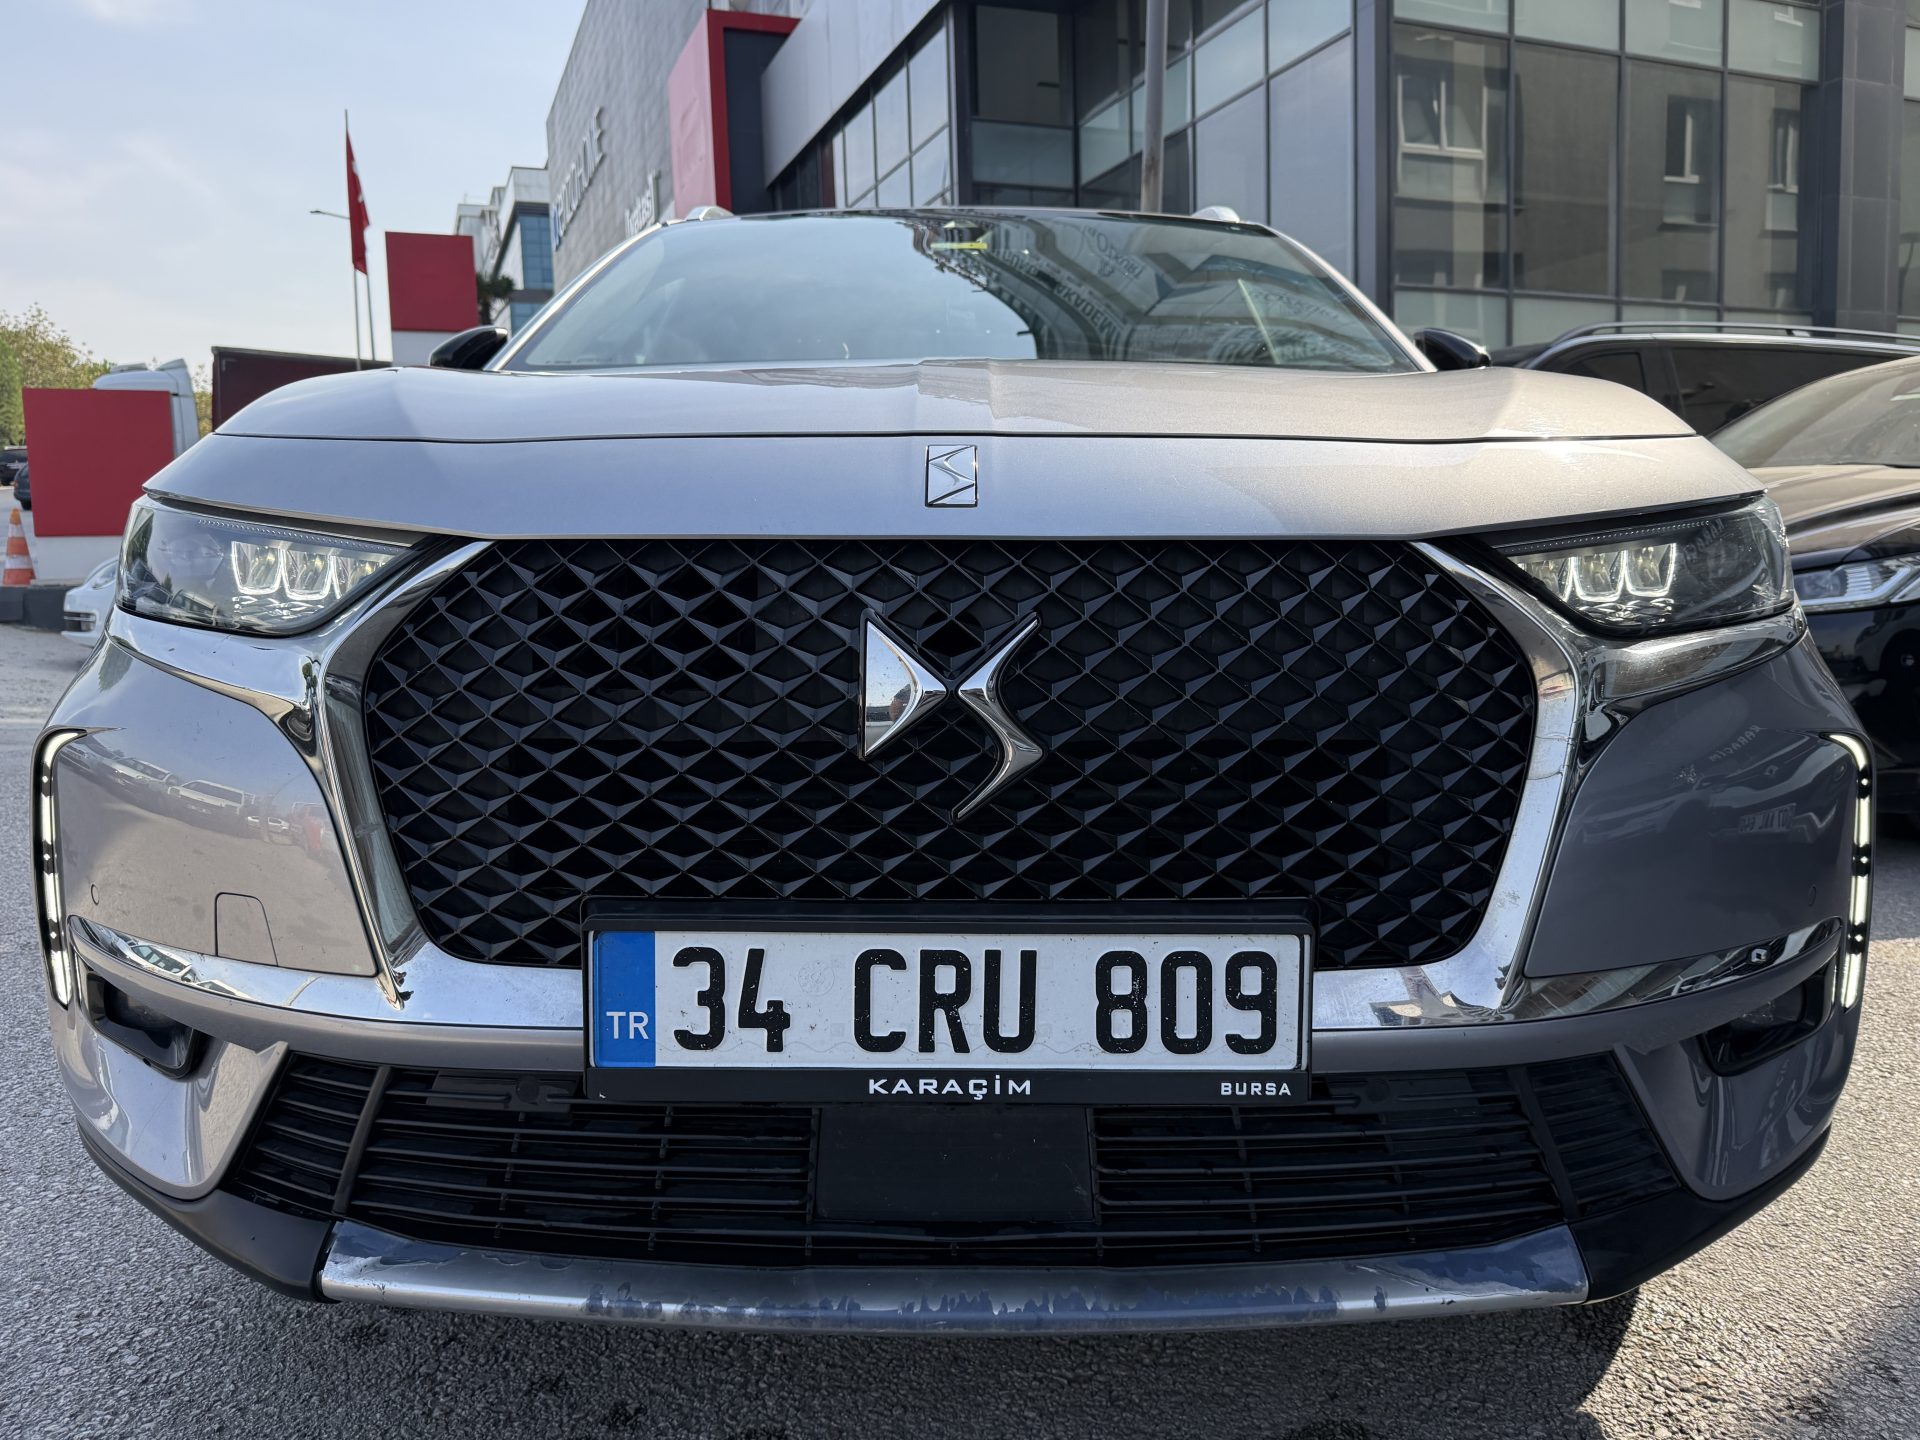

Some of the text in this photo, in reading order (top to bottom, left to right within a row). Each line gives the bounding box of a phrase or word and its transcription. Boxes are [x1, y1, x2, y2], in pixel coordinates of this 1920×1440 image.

[672, 946, 1278, 1055] 34 CRU 809
[606, 1011, 649, 1039] TR
[868, 1074, 1031, 1101] KARAÇİM
[1220, 1082, 1291, 1096] BURSA
